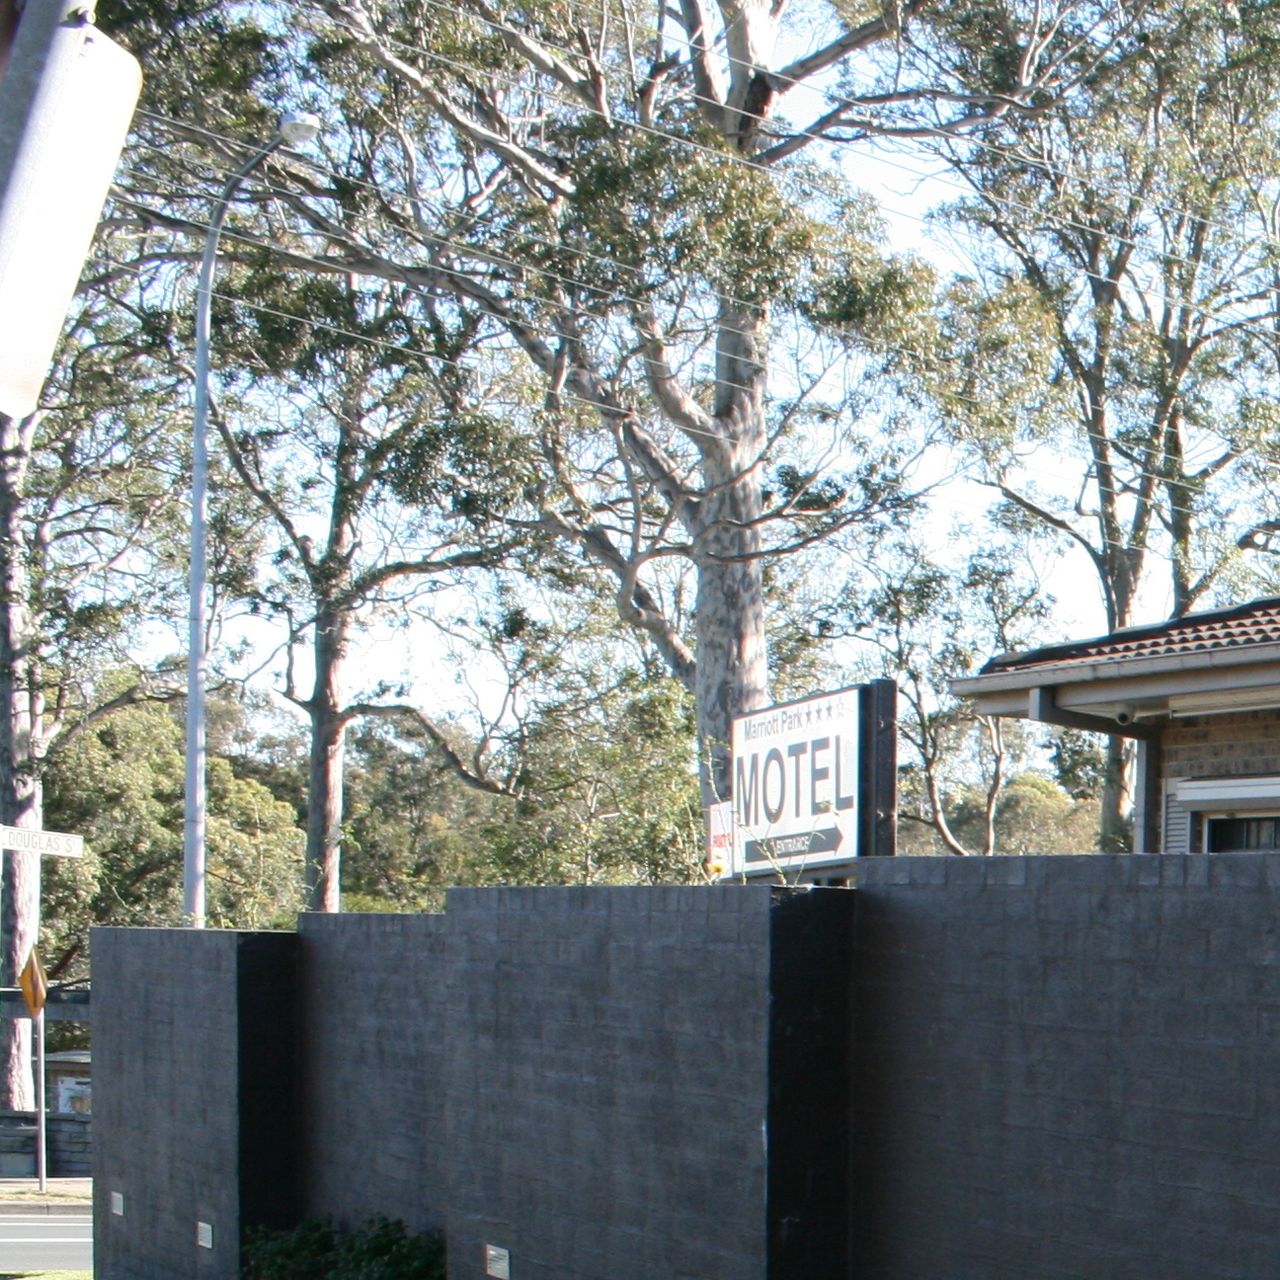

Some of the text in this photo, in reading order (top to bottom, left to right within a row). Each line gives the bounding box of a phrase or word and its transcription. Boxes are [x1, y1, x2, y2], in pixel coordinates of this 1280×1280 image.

[744, 706, 803, 741] Marriott Park
[736, 735, 854, 827] MOTEL
[9, 831, 60, 852] DOUGLAS
